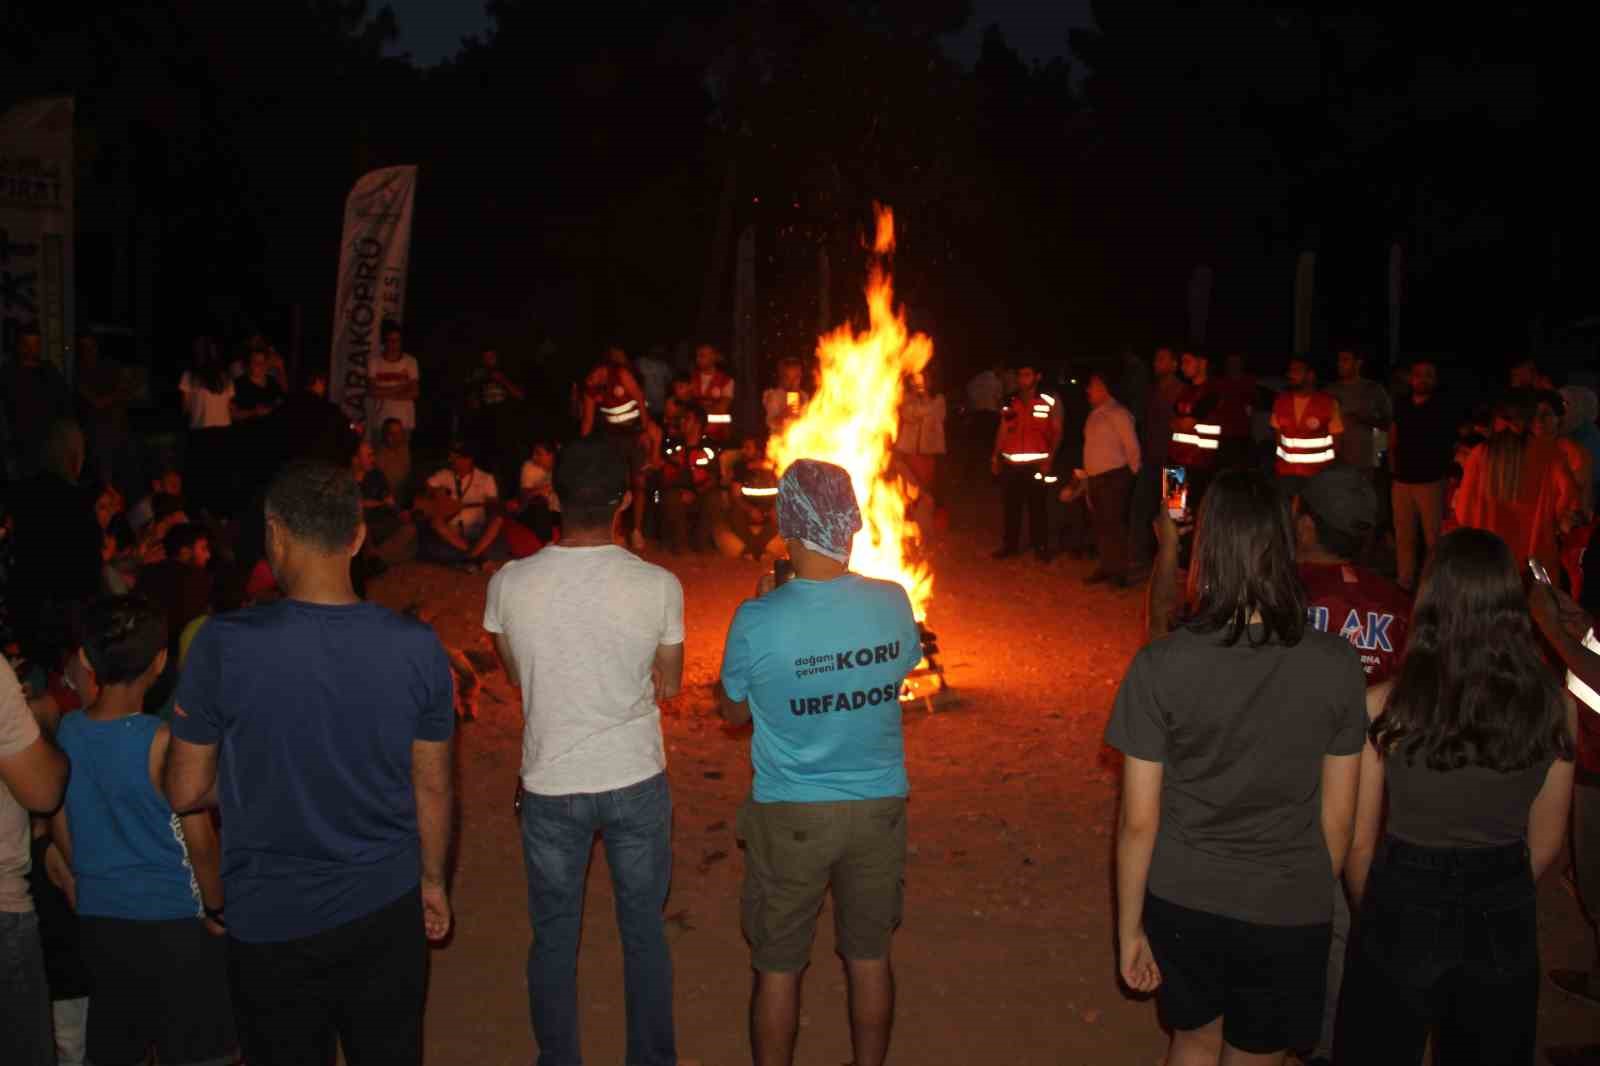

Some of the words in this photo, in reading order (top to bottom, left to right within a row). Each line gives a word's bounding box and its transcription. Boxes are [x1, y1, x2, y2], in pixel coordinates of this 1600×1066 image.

[344, 237, 383, 421] ARAKÖPRÜ
[837, 640, 900, 670] KORU
[796, 663, 834, 678] çevreni
